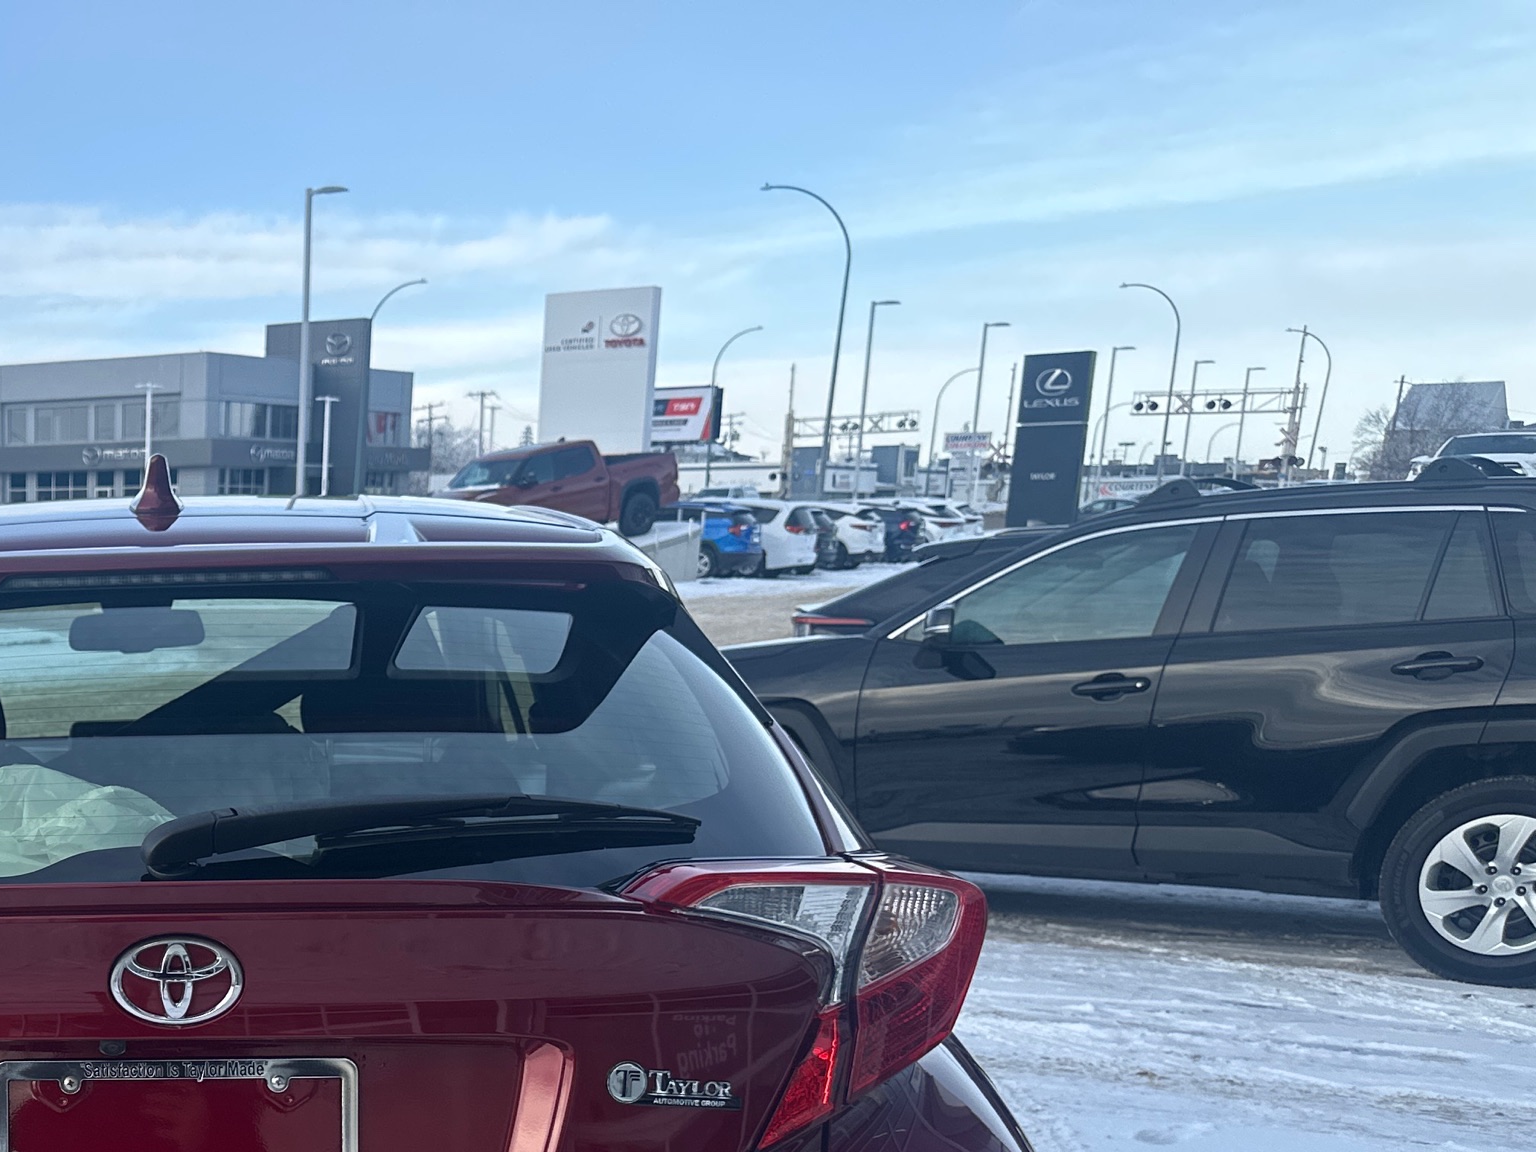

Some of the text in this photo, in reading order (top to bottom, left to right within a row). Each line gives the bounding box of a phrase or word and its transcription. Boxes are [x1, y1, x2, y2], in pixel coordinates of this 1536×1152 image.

[605, 338, 646, 349] TOYOTA
[1023, 397, 1080, 408] LEXUS
[167, 1063, 179, 1078] is
[182, 1062, 224, 1083] Taylor
[653, 1097, 726, 1107] AUTOMOTIVE GROUP
